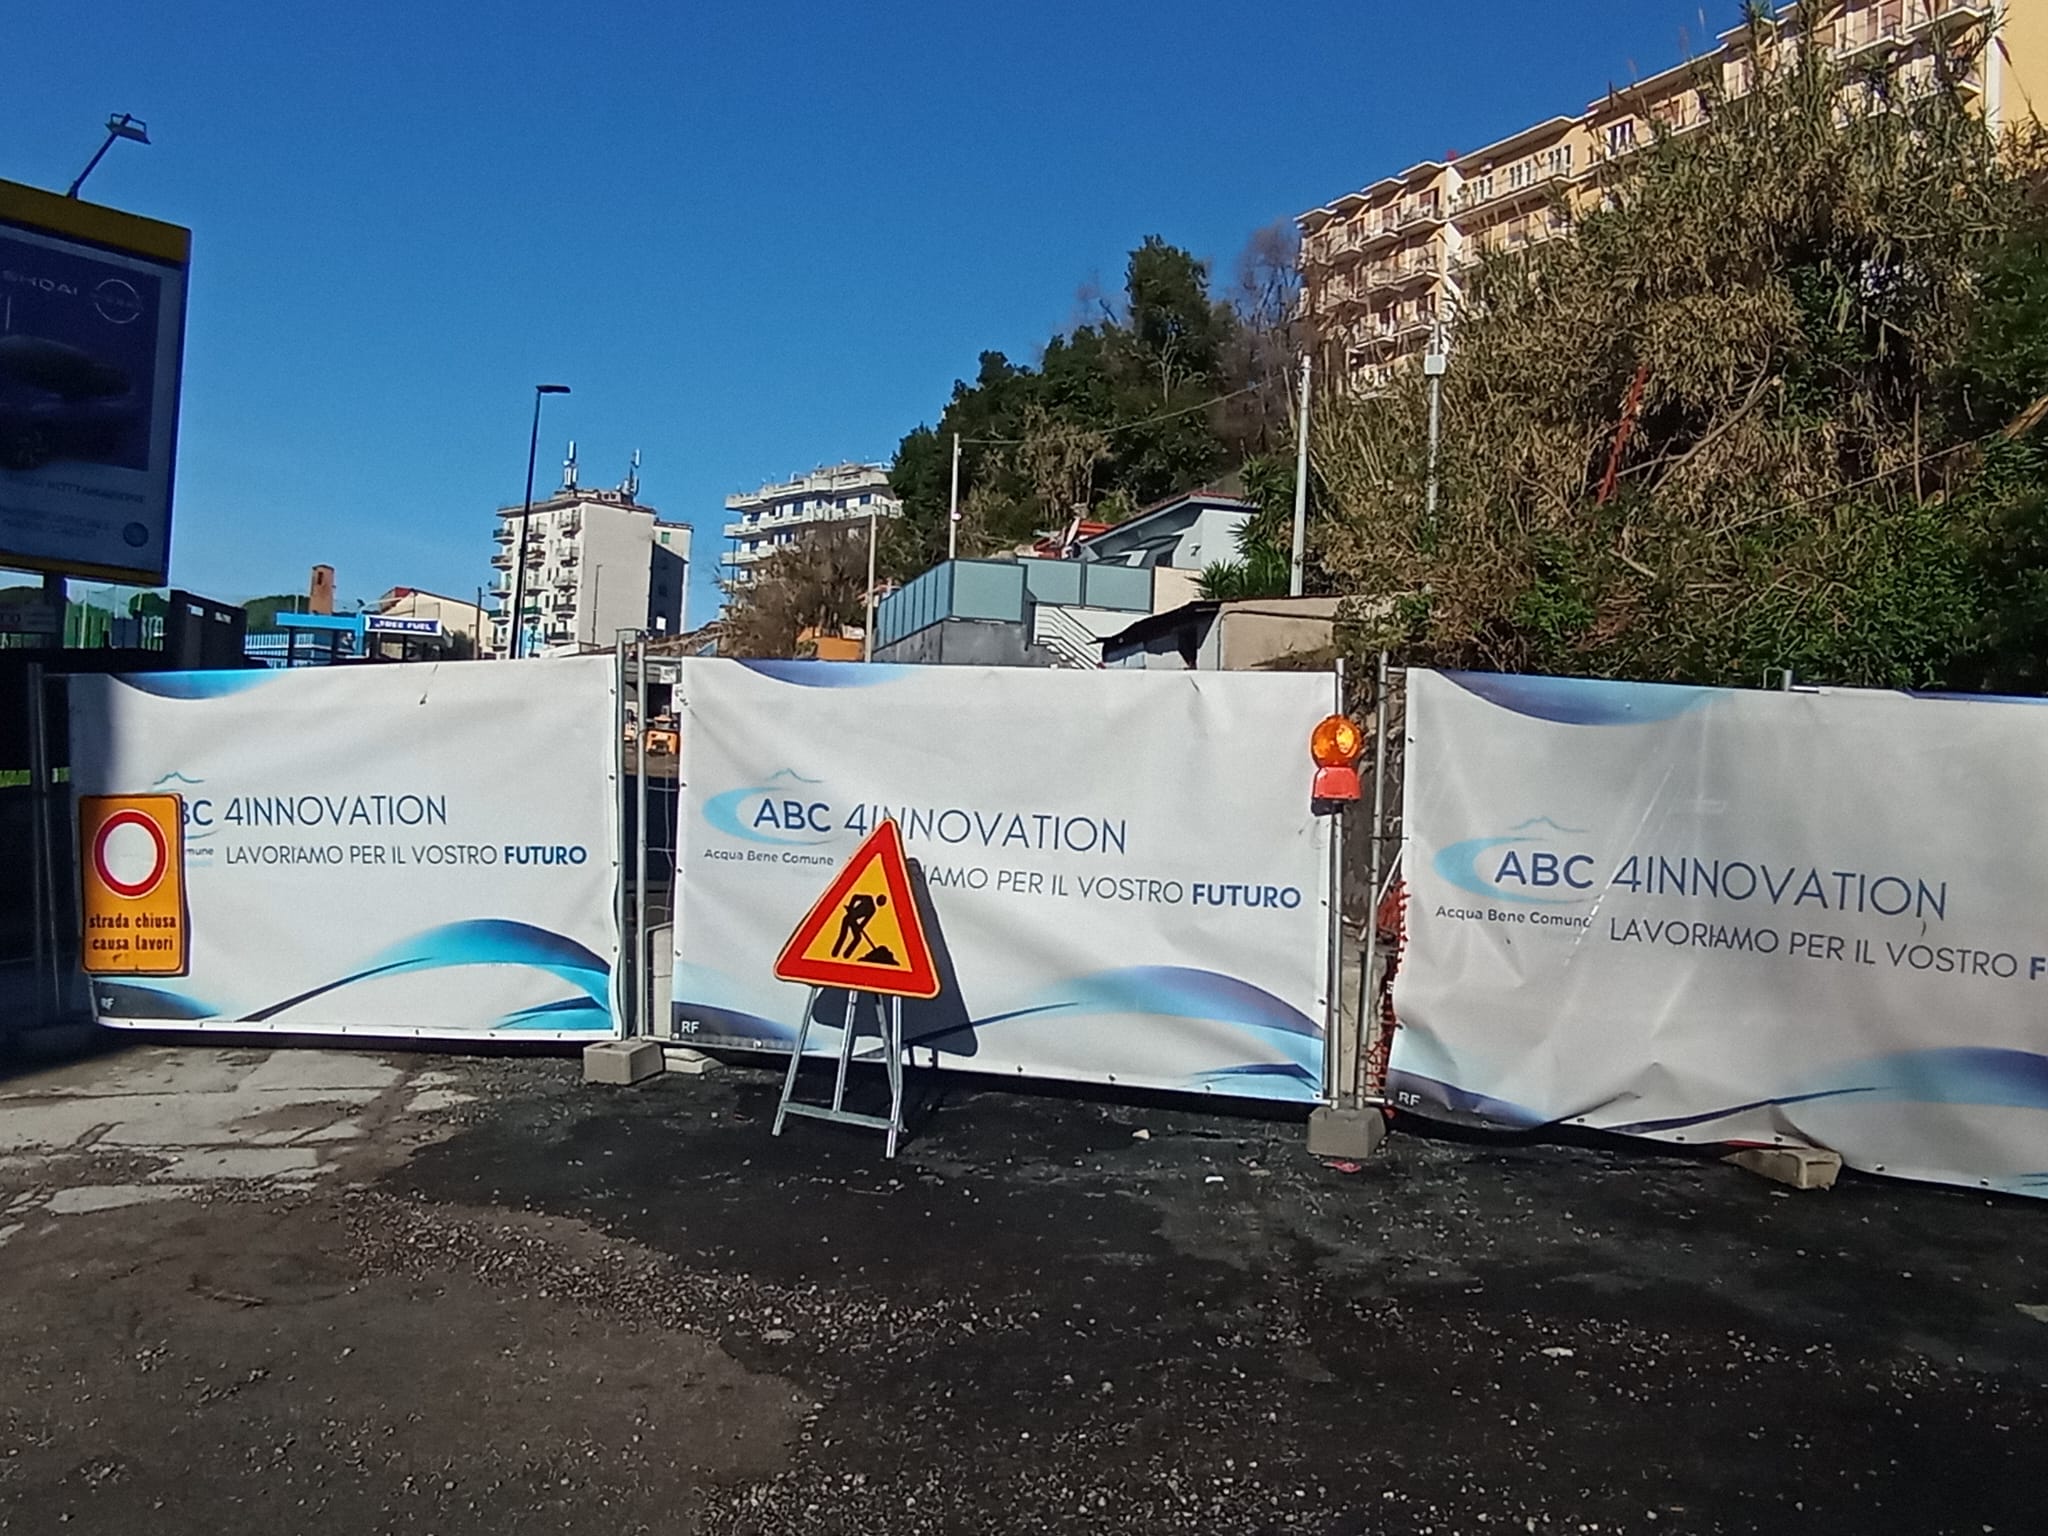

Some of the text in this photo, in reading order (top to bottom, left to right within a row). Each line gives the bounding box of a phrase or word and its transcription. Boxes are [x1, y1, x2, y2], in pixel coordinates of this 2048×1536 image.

[183, 795, 447, 826] BC 4INNOVATION
[753, 798, 831, 832] ABC
[186, 848, 214, 856] mune
[226, 845, 343, 865] LAVORIAMO
[350, 845, 386, 865] PER
[392, 846, 406, 865] IL
[412, 845, 498, 865] VOSTRO
[504, 845, 588, 865] FUTURO
[704, 849, 834, 866] Acqua Bene Comune
[997, 869, 1044, 894] PER
[1052, 874, 1069, 897] IL
[1077, 876, 1184, 904] VOSTRO
[1192, 882, 1302, 909] FUTURO
[1495, 850, 1947, 921] ABC 4INNOVATION
[89, 912, 176, 928] strada chiusa
[1436, 905, 1483, 920] Acqua
[1488, 908, 1526, 923] Bene
[92, 934, 173, 951] causa lavori
[1611, 917, 1779, 953] LAVORIAMO
[1789, 931, 1845, 961] PER
[1855, 939, 1876, 965] IL
[1886, 941, 2018, 978] VOSTRO
[681, 1020, 700, 1034] RF
[1398, 1091, 1421, 1106] RF
